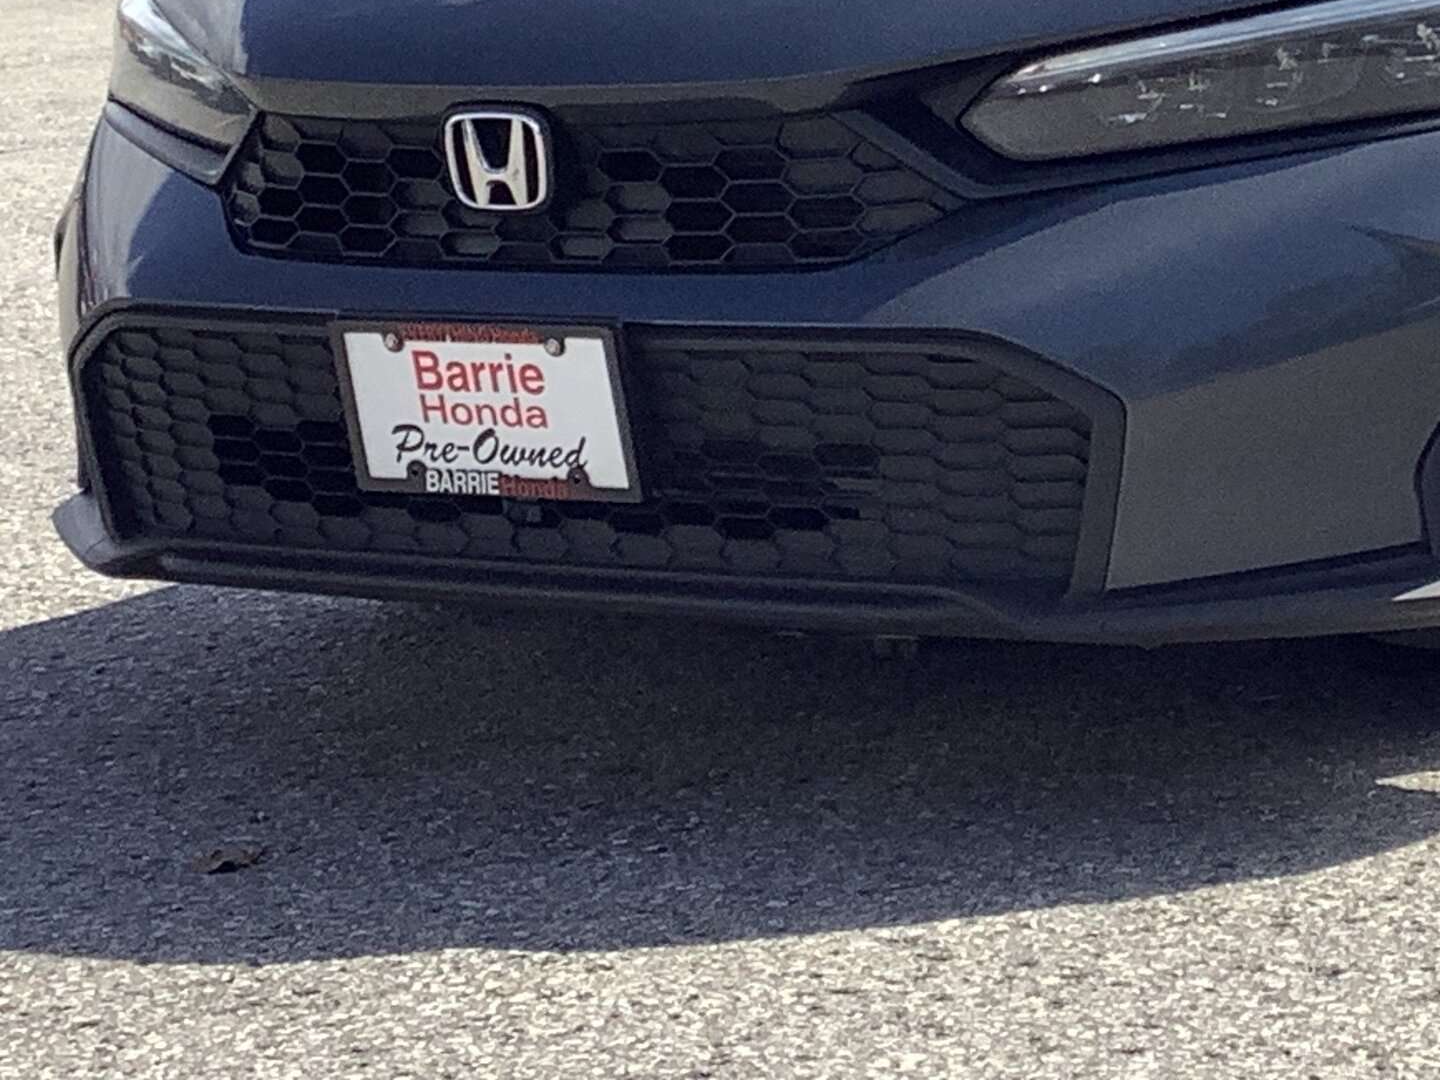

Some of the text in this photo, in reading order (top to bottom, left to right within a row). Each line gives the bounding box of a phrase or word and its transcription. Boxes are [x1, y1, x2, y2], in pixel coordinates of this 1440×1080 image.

[411, 349, 546, 395] Barrie
[418, 393, 549, 429] Honda
[391, 423, 588, 469] Pre-Owned
